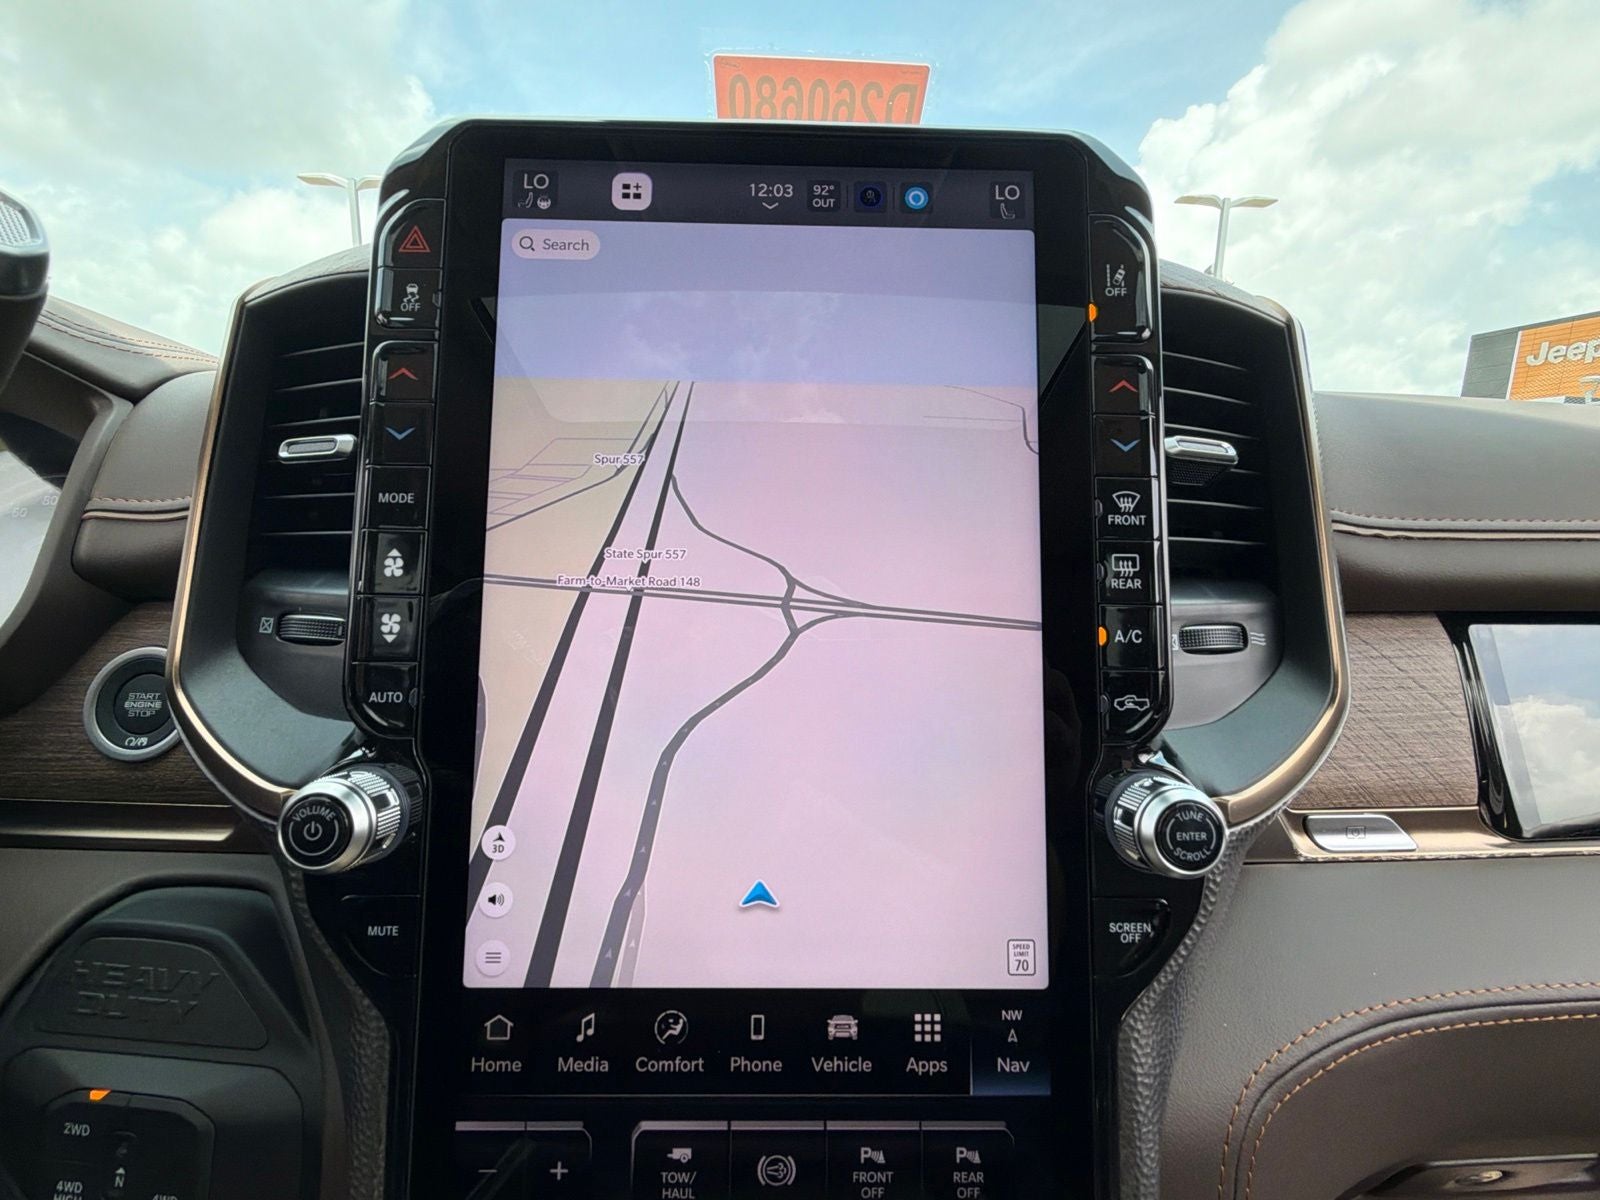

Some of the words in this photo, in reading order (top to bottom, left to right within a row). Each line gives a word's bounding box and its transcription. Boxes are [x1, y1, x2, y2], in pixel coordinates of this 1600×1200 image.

[523, 173, 549, 189] LO
[750, 183, 793, 197] 12:03
[813, 184, 835, 196] 92°
[995, 185, 1020, 200] LO
[812, 198, 835, 208] OUT
[542, 239, 590, 251] Search
[1105, 287, 1127, 297] OFF
[400, 302, 421, 312] OFF
[594, 454, 620, 465] Spur
[623, 454, 645, 464] 557
[378, 492, 415, 504] MODE
[1107, 515, 1146, 526] FRONT
[604, 549, 634, 559] State
[637, 549, 663, 561] Spur
[665, 549, 687, 559] 557
[557, 575, 645, 587] Farm-to-Market
[648, 576, 677, 587] Road
[681, 577, 701, 587] 148
[1111, 578, 1142, 590] REAR
[1114, 629, 1143, 644] A/C
[128, 692, 160, 700] START
[368, 691, 403, 703] AUTO
[124, 701, 162, 709] ENGINE
[128, 709, 156, 718] STOP
[291, 805, 336, 821] VOLUME
[1175, 808, 1205, 823] TUNE
[1176, 831, 1208, 841] ENTER
[492, 844, 505, 854] 3D
[1173, 847, 1212, 861] SCROLL
[367, 925, 399, 937] MUTE
[1109, 922, 1151, 933] SCREEN
[1120, 933, 1141, 944] OFF
[1015, 959, 1030, 972] 70
[73, 959, 221, 994] HEAVY
[1001, 1010, 1023, 1021] NW
[471, 1056, 522, 1072] Home
[557, 1056, 609, 1072] Media
[635, 1056, 704, 1072] Comfort
[730, 1056, 783, 1072] Phone
[811, 1056, 872, 1072] Vehicle
[906, 1057, 948, 1076] Apps
[997, 1057, 1030, 1073] Nav
[63, 1122, 91, 1137] 2WD
[114, 1175, 125, 1188] N
[661, 1171, 697, 1184] TOW/
[852, 1171, 894, 1183] FRONT
[953, 1171, 984, 1183] REAR
[56, 1180, 83, 1194] 4WD
[661, 1187, 696, 1199] HAUL
[860, 1187, 884, 1199] OFF
[956, 1187, 980, 1199] OFF
